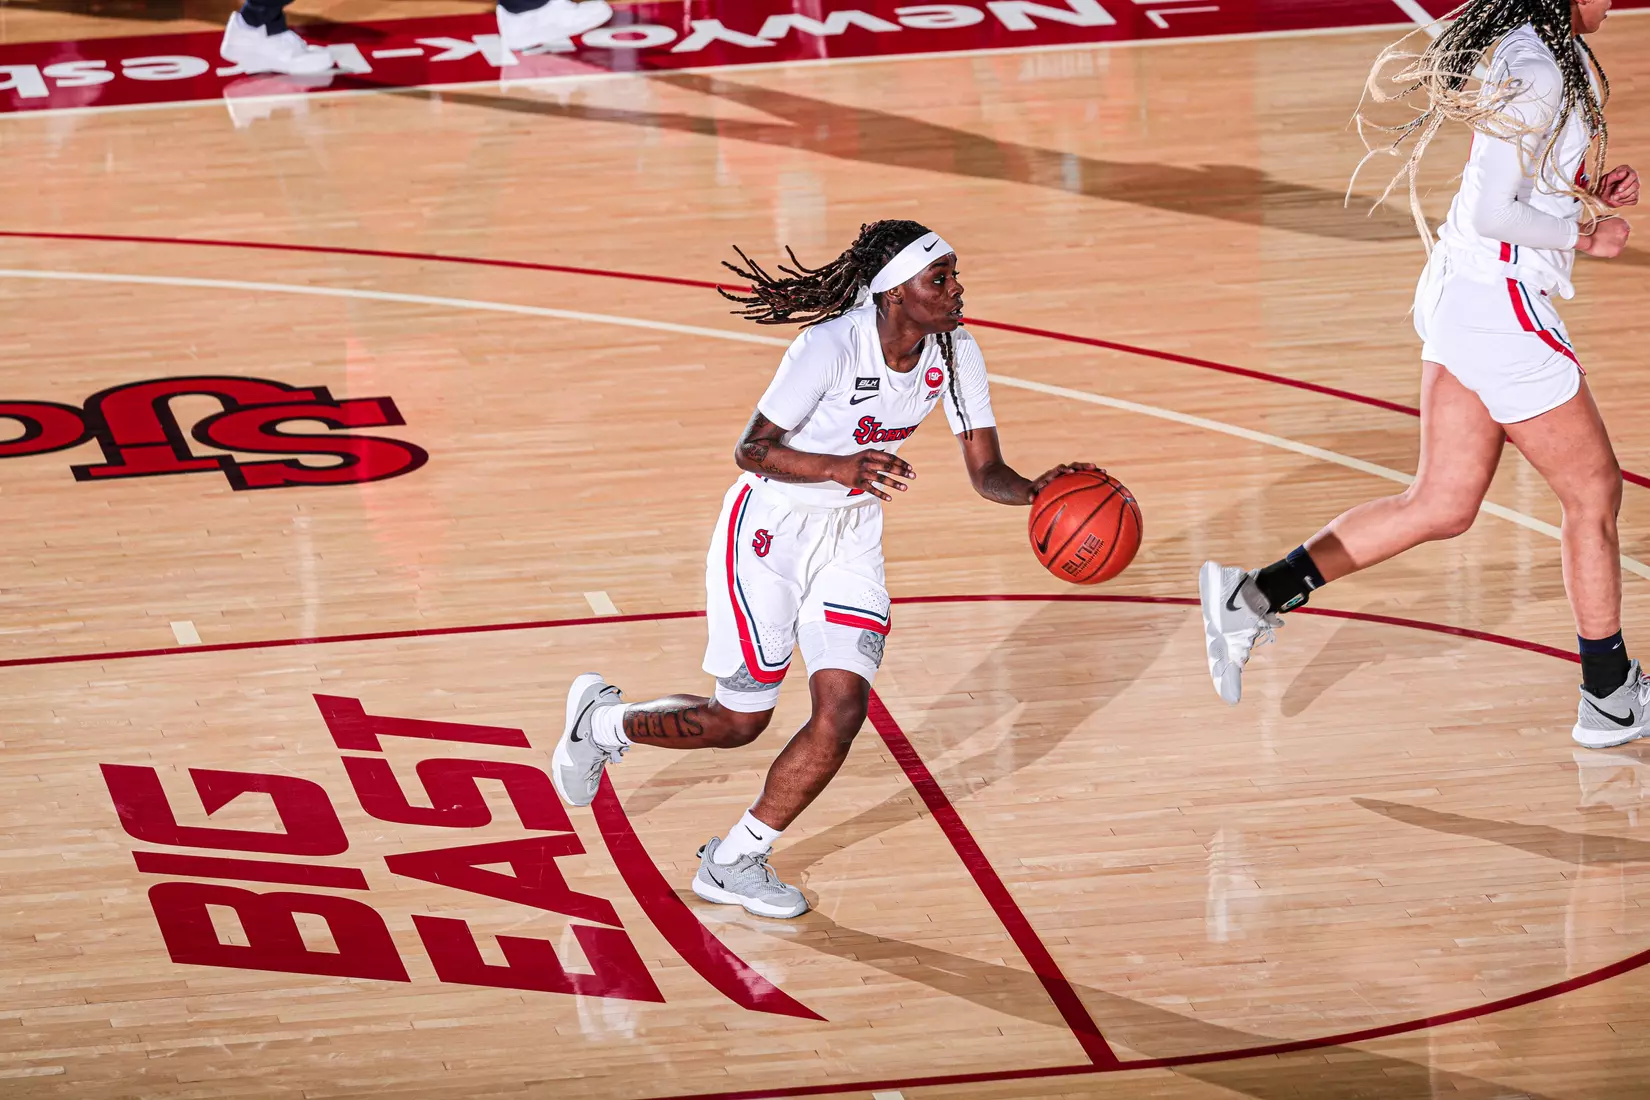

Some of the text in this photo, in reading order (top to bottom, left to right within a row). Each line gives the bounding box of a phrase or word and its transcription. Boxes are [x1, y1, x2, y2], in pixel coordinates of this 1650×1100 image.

[859, 379, 878, 387] BLM
[1061, 533, 1102, 575] ELITE
[99, 694, 666, 1003] BIG EAST
